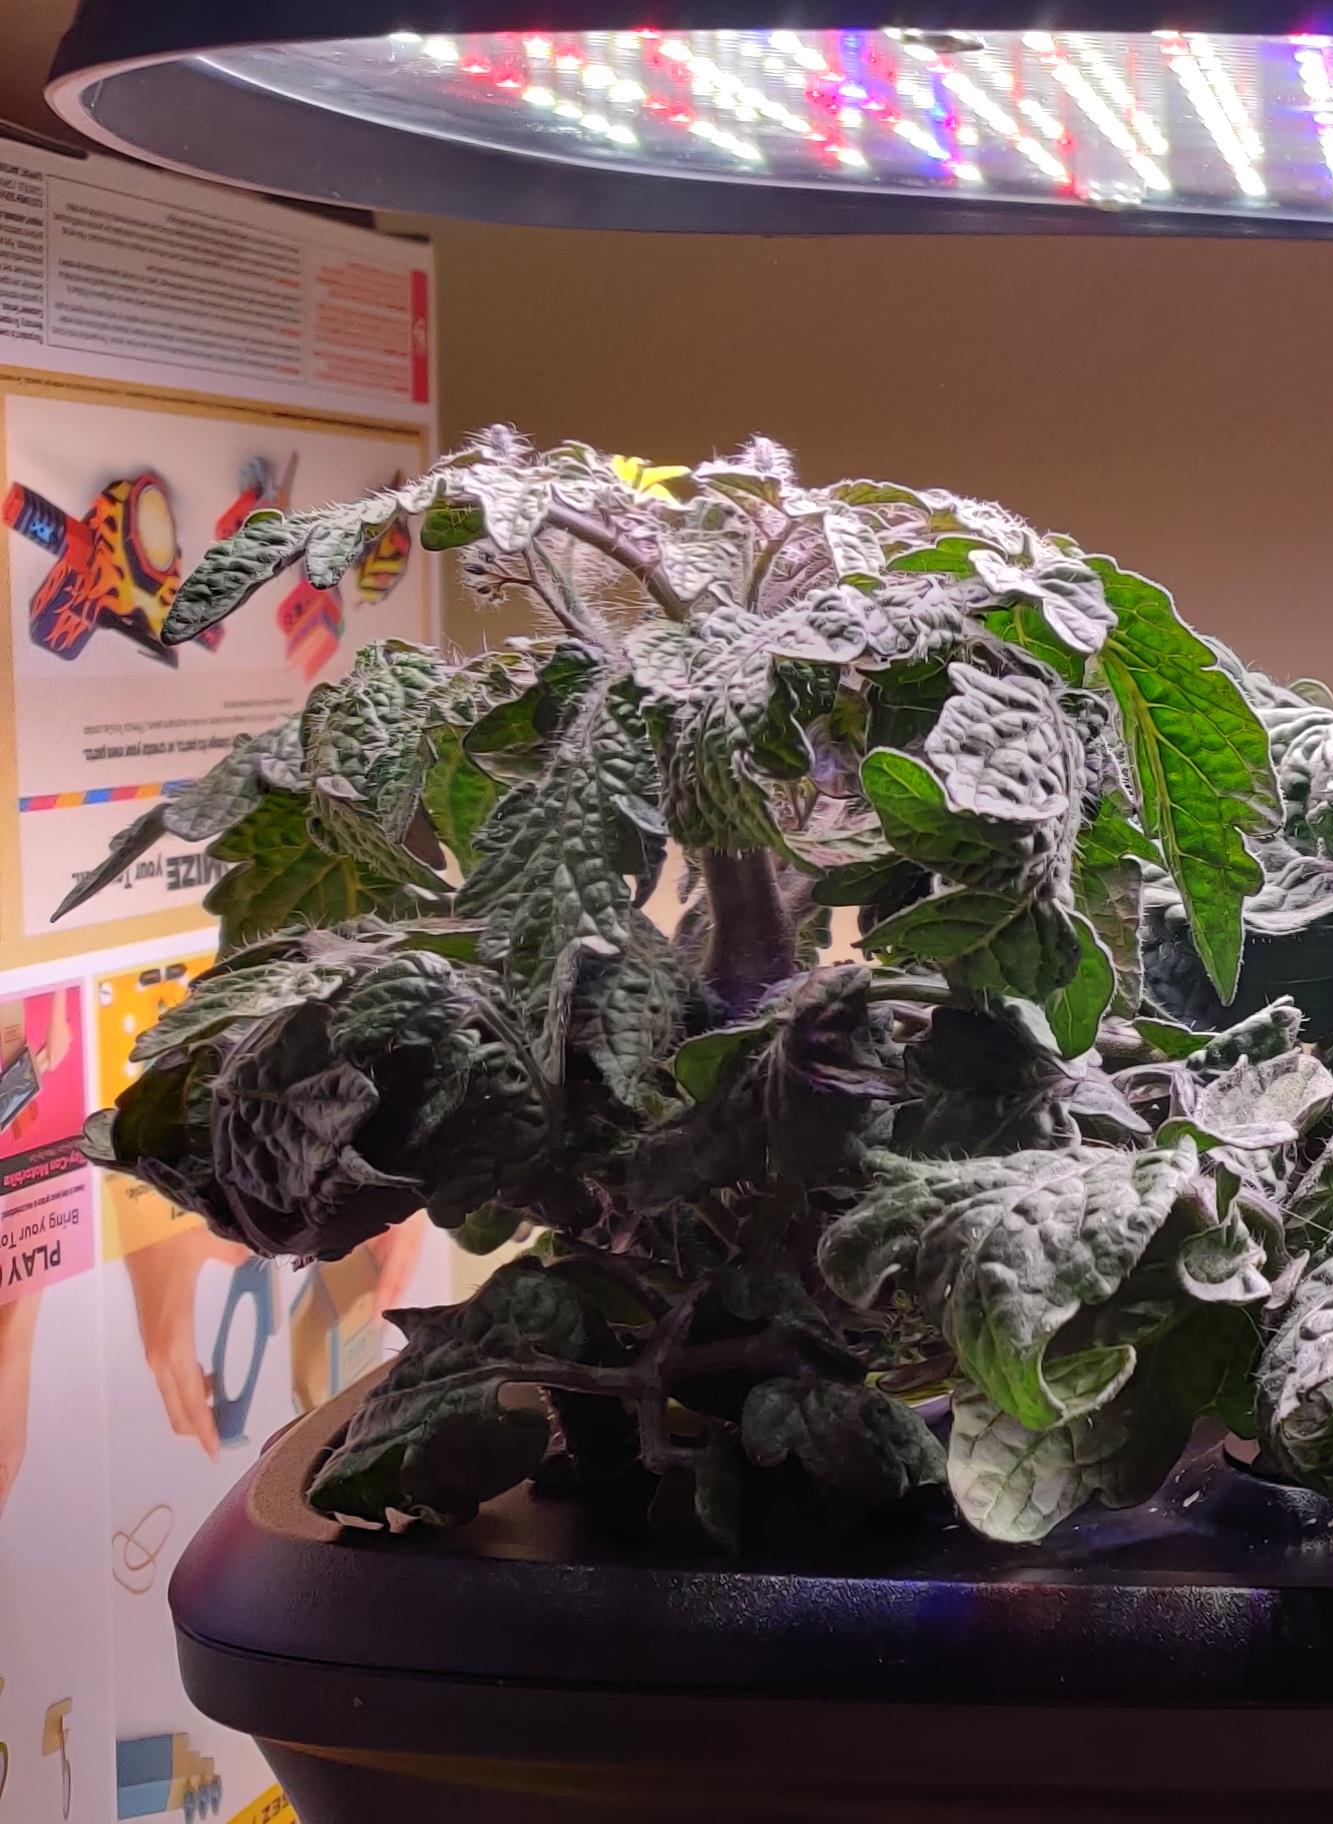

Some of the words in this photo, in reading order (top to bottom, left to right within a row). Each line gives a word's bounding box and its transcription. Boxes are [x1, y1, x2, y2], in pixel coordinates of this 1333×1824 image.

[135, 853, 162, 880] your
[167, 853, 226, 891] MIZE
[19, 1215, 46, 1242] your
[50, 1208, 79, 1229] Bring
[8, 1240, 61, 1286] PLAY
